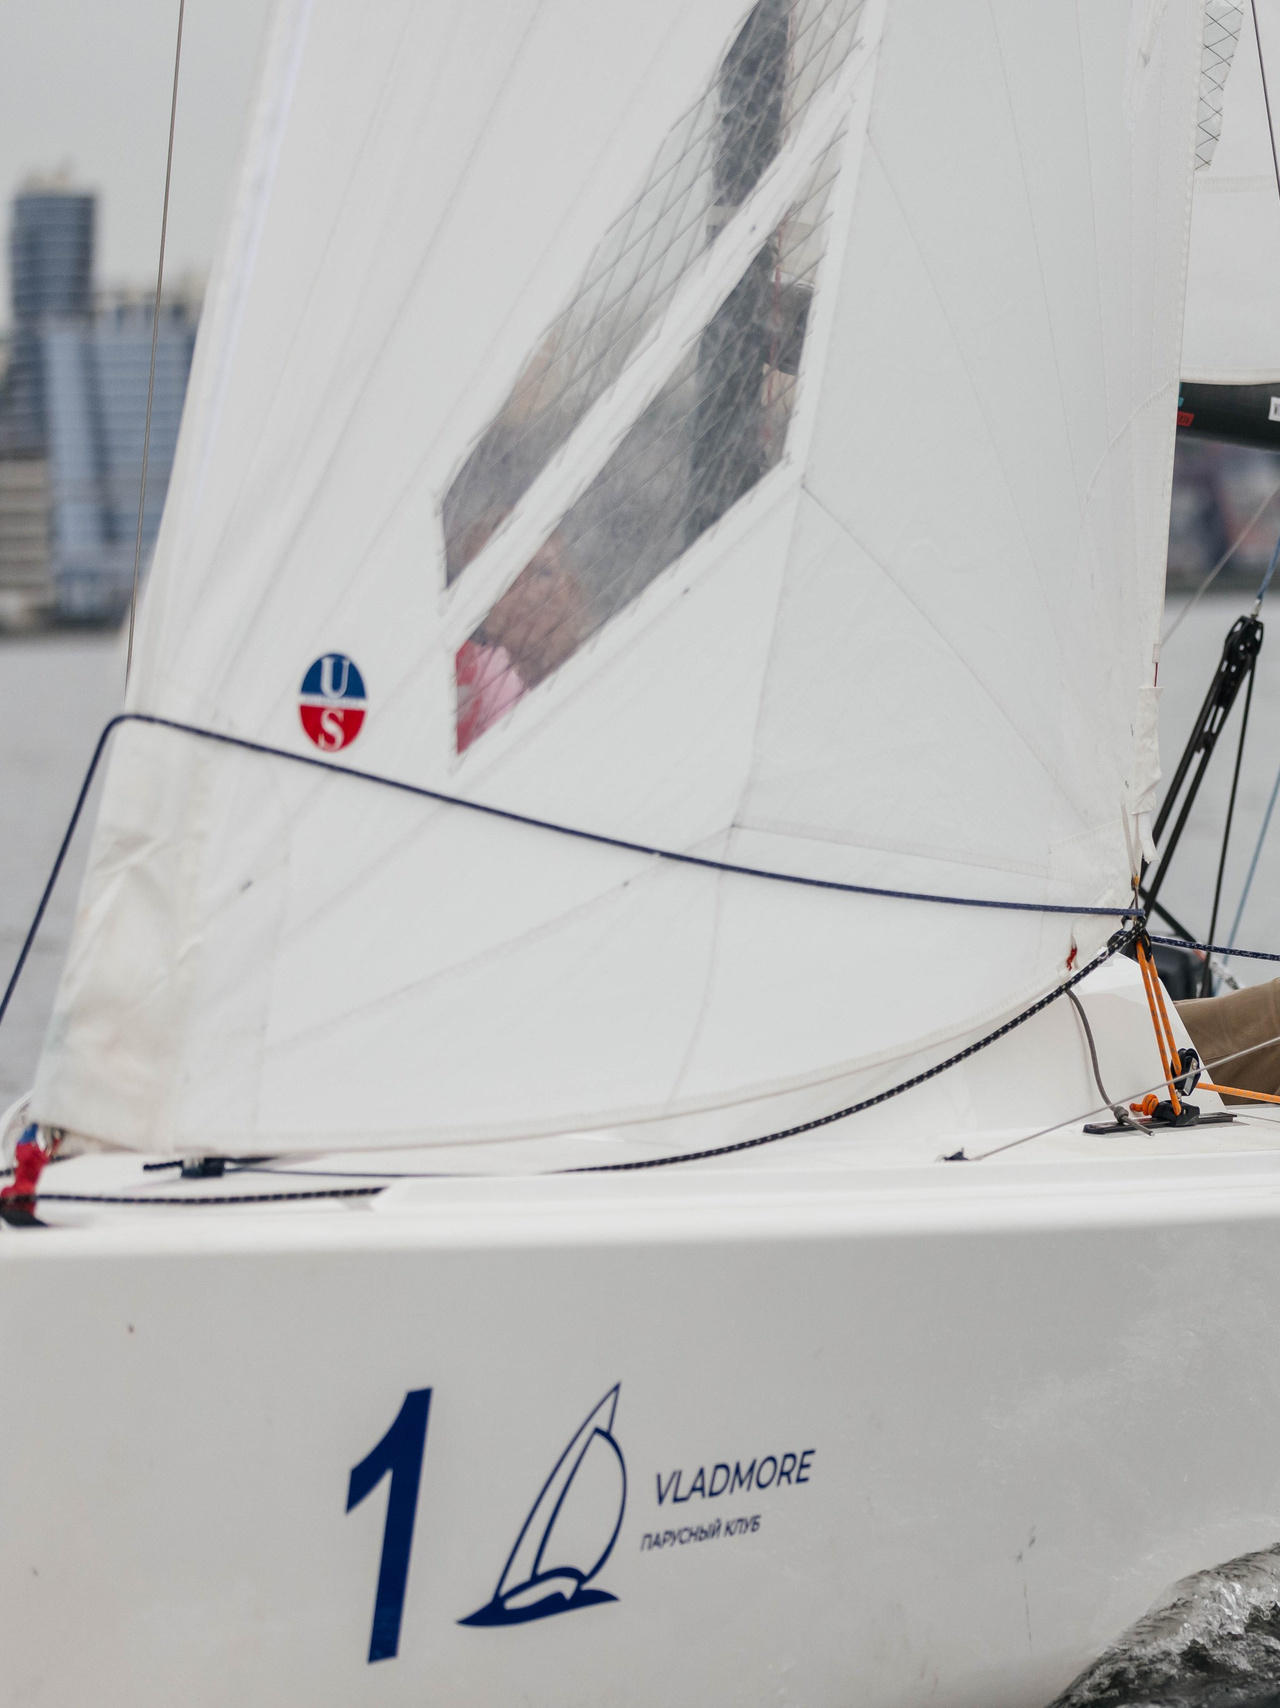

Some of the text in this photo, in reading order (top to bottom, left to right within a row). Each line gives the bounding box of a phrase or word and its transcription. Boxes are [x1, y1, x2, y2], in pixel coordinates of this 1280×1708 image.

[320, 656, 350, 698] U
[318, 708, 345, 752] S
[655, 1449, 816, 1506] VLADMORE
[345, 1386, 434, 1665] 1
[640, 1514, 762, 1552] ПАРУСНЫЙ КЛУБ
